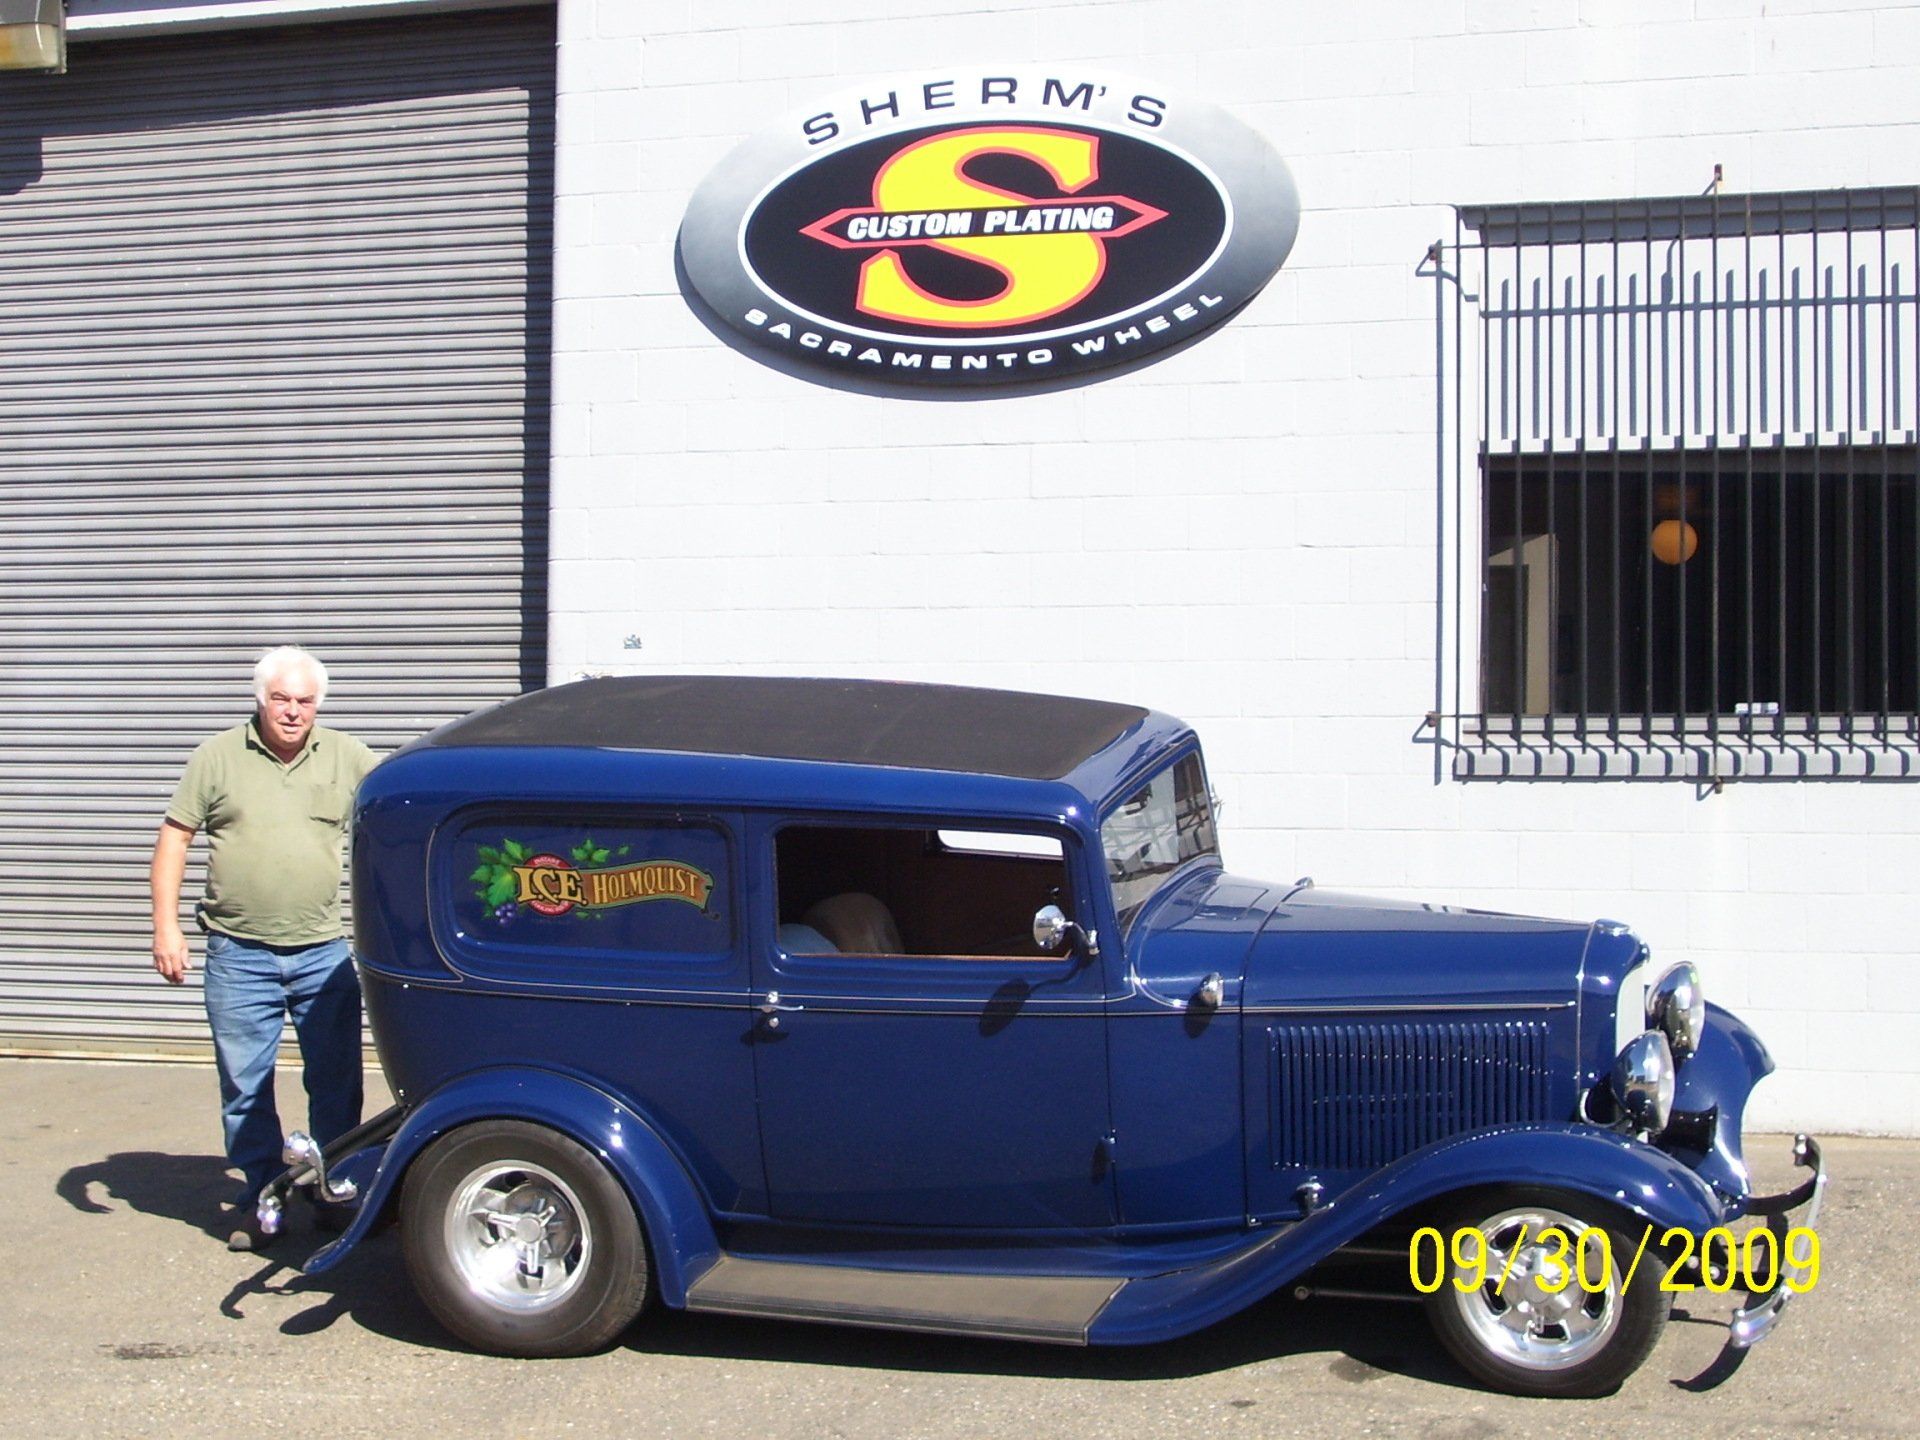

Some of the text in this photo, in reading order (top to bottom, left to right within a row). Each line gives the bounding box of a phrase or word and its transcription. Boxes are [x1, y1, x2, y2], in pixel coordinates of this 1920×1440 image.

[802, 77, 1167, 146] SHERM'S
[847, 206, 1115, 240] CUSTOM PLATING
[855, 125, 1107, 330] S
[743, 293, 1224, 370] SACRAMENTO WHEEL
[592, 866, 699, 904] HOLMQUIST
